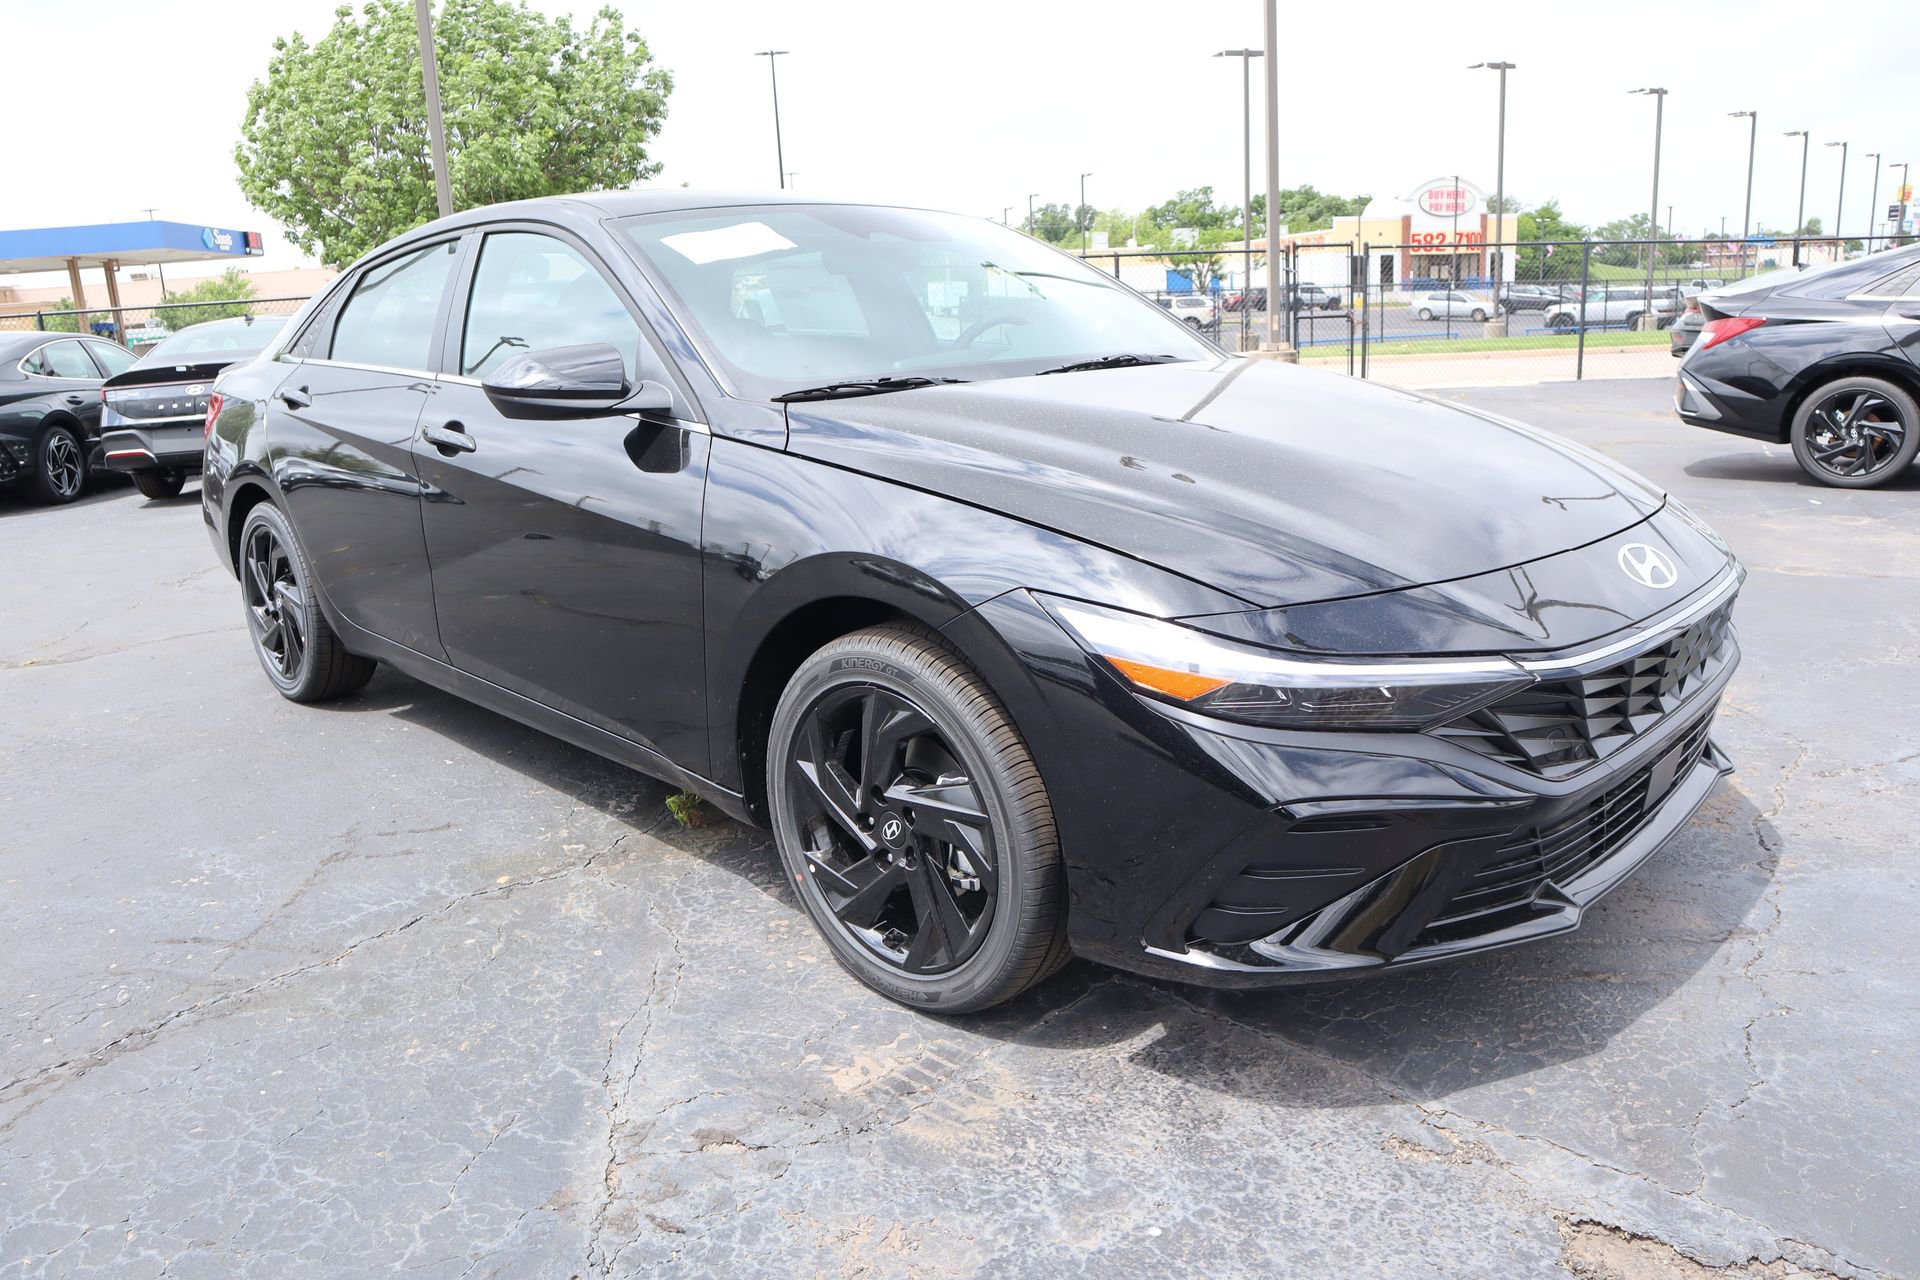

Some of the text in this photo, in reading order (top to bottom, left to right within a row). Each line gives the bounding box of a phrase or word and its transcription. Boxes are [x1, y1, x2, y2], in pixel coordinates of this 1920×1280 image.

[1428, 190, 1443, 199] BUY
[1428, 202, 1443, 212] PAY
[886, 667, 899, 677] GT
